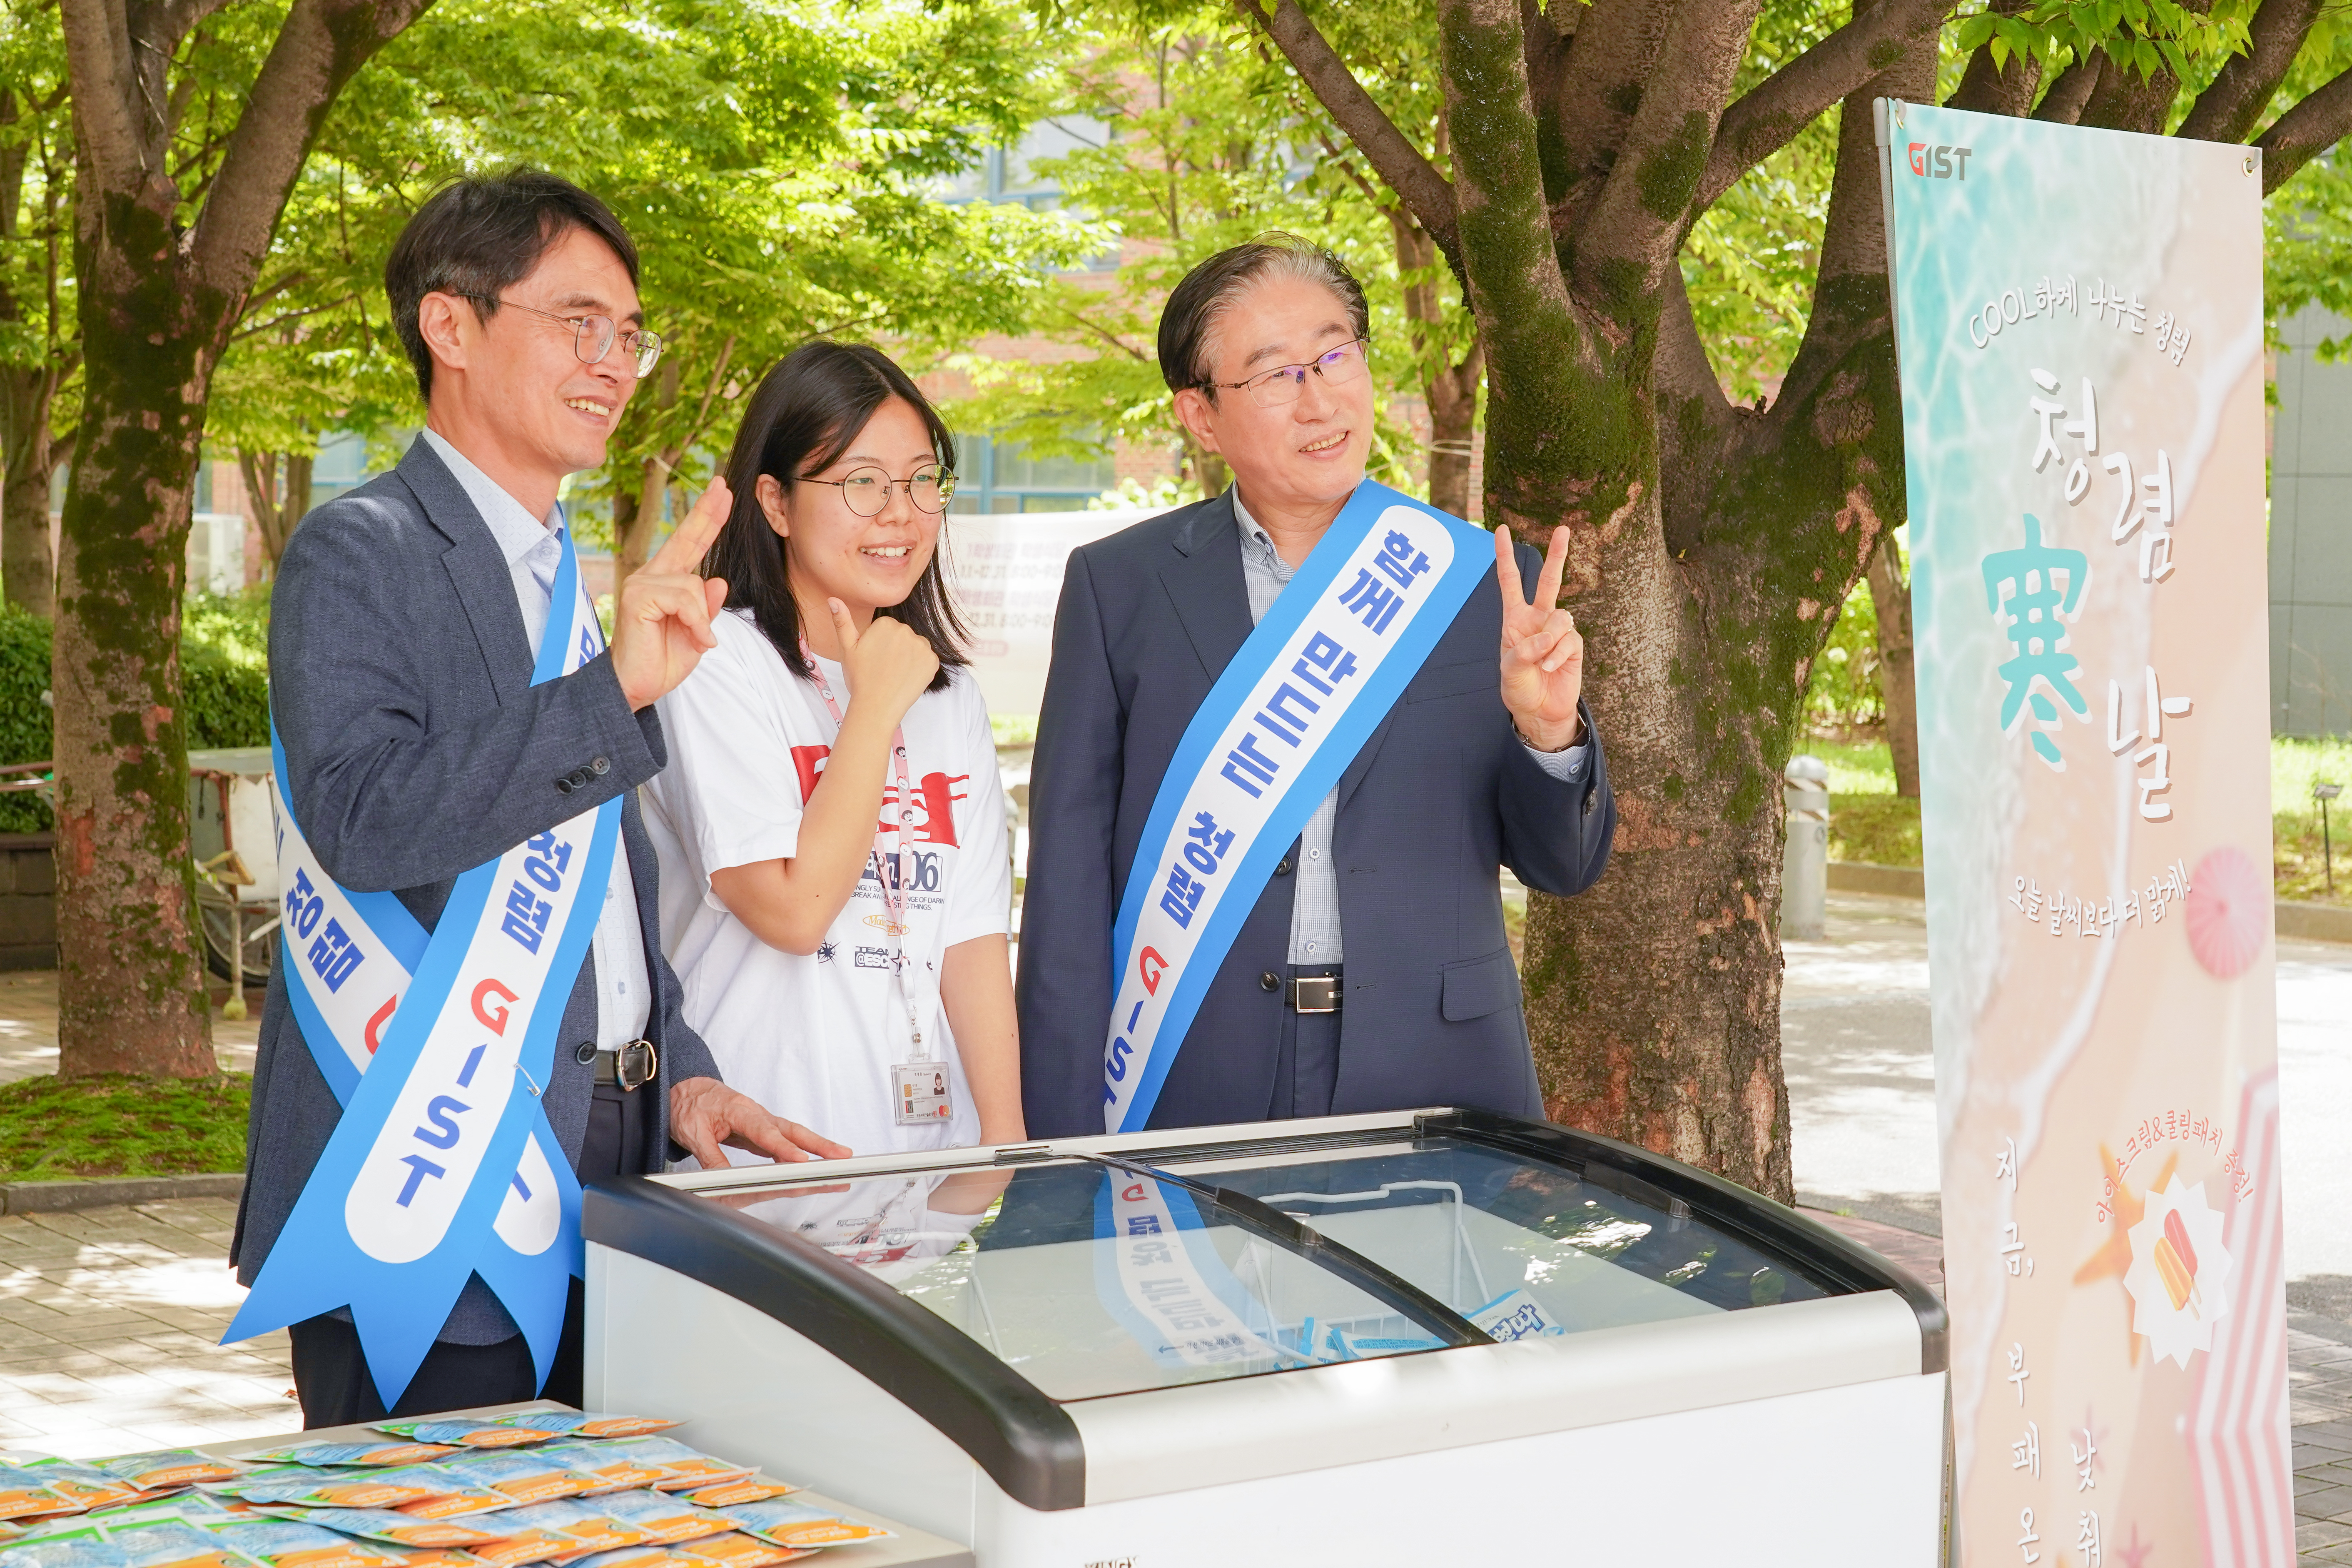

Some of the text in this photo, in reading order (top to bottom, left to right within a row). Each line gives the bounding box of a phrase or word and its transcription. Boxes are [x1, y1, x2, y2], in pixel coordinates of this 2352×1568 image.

[1908, 142, 1972, 181] GIST
[1969, 274, 2191, 366] COOL하게 나누는 청렴
[1338, 529, 1431, 636] 함께
[1982, 513, 2089, 764] 寒
[2030, 368, 2192, 819] 청렴 날
[1221, 630, 1358, 799] 만드는
[1160, 810, 1236, 930] 청렴
[2008, 858, 2192, 938] 오늘 날씨보다 더 맑게!
[286, 866, 365, 995] 청렴
[856, 952, 889, 968] @ESC
[396, 830, 573, 1208] 청렴 GIST
[1996, 1136, 2034, 1276] 지금,
[2096, 1109, 2254, 1223] 아이스크림&쿨링패치 증정!
